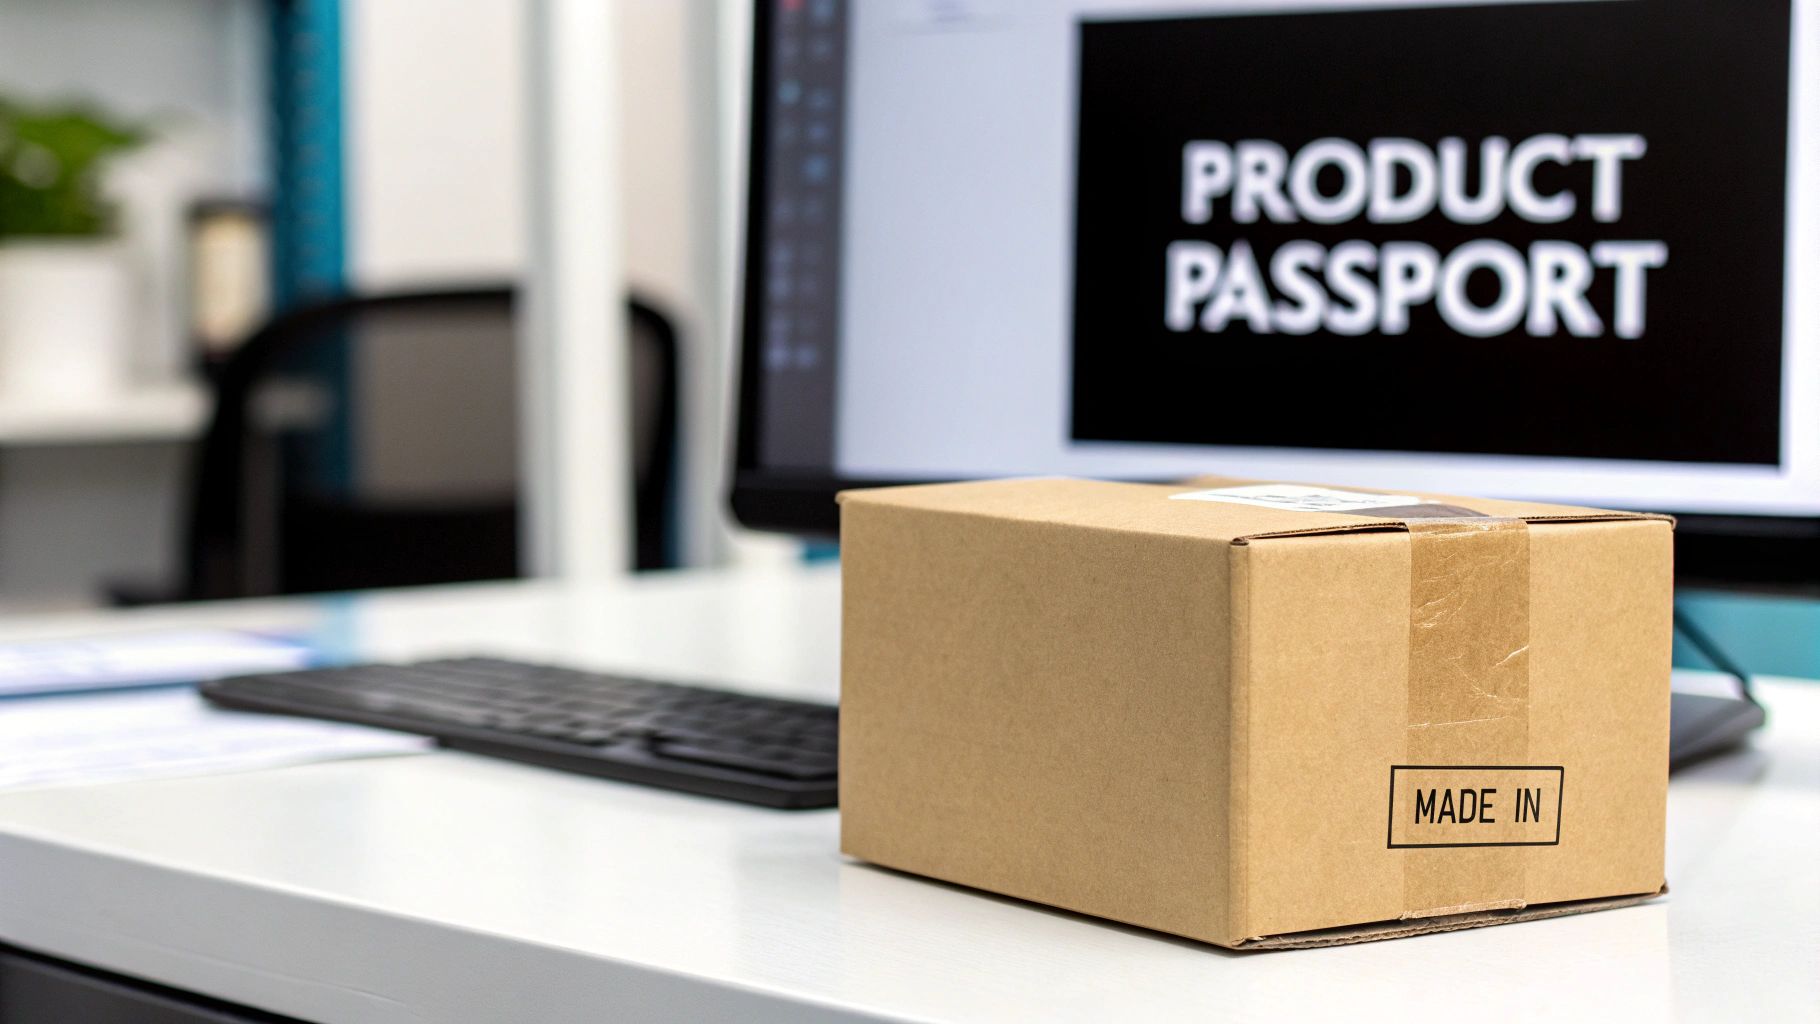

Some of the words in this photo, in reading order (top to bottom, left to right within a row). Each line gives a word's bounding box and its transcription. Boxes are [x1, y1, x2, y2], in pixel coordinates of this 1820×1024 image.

[1183, 134, 1646, 223] PRODUCT
[1166, 240, 1667, 338] PASSPORT
[1415, 788, 1497, 824] MADE
[1514, 787, 1541, 823] IN
